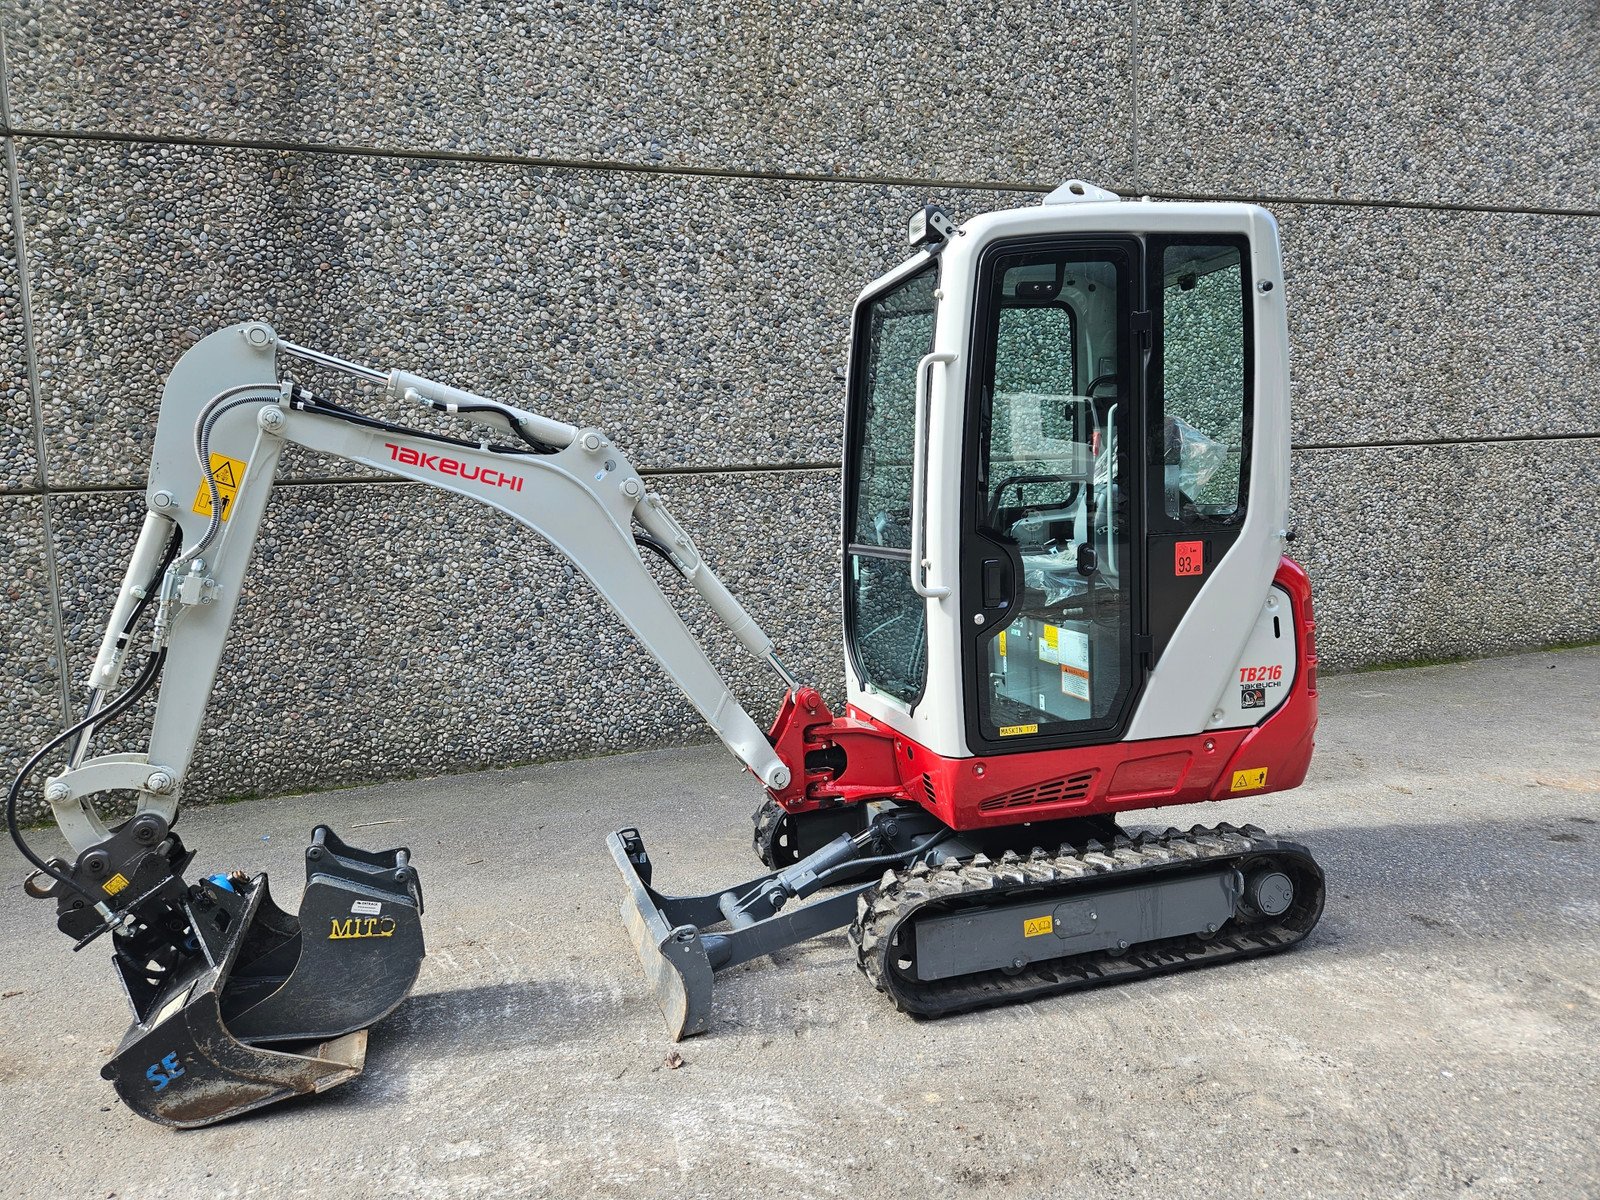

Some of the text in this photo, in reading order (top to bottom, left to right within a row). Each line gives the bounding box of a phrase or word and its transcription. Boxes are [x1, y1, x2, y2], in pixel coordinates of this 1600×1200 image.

[1179, 557, 1191, 572] 93
[1240, 665, 1282, 682] TB216
[1001, 727, 1022, 735] MASKIN
[147, 1051, 186, 1092] SE
